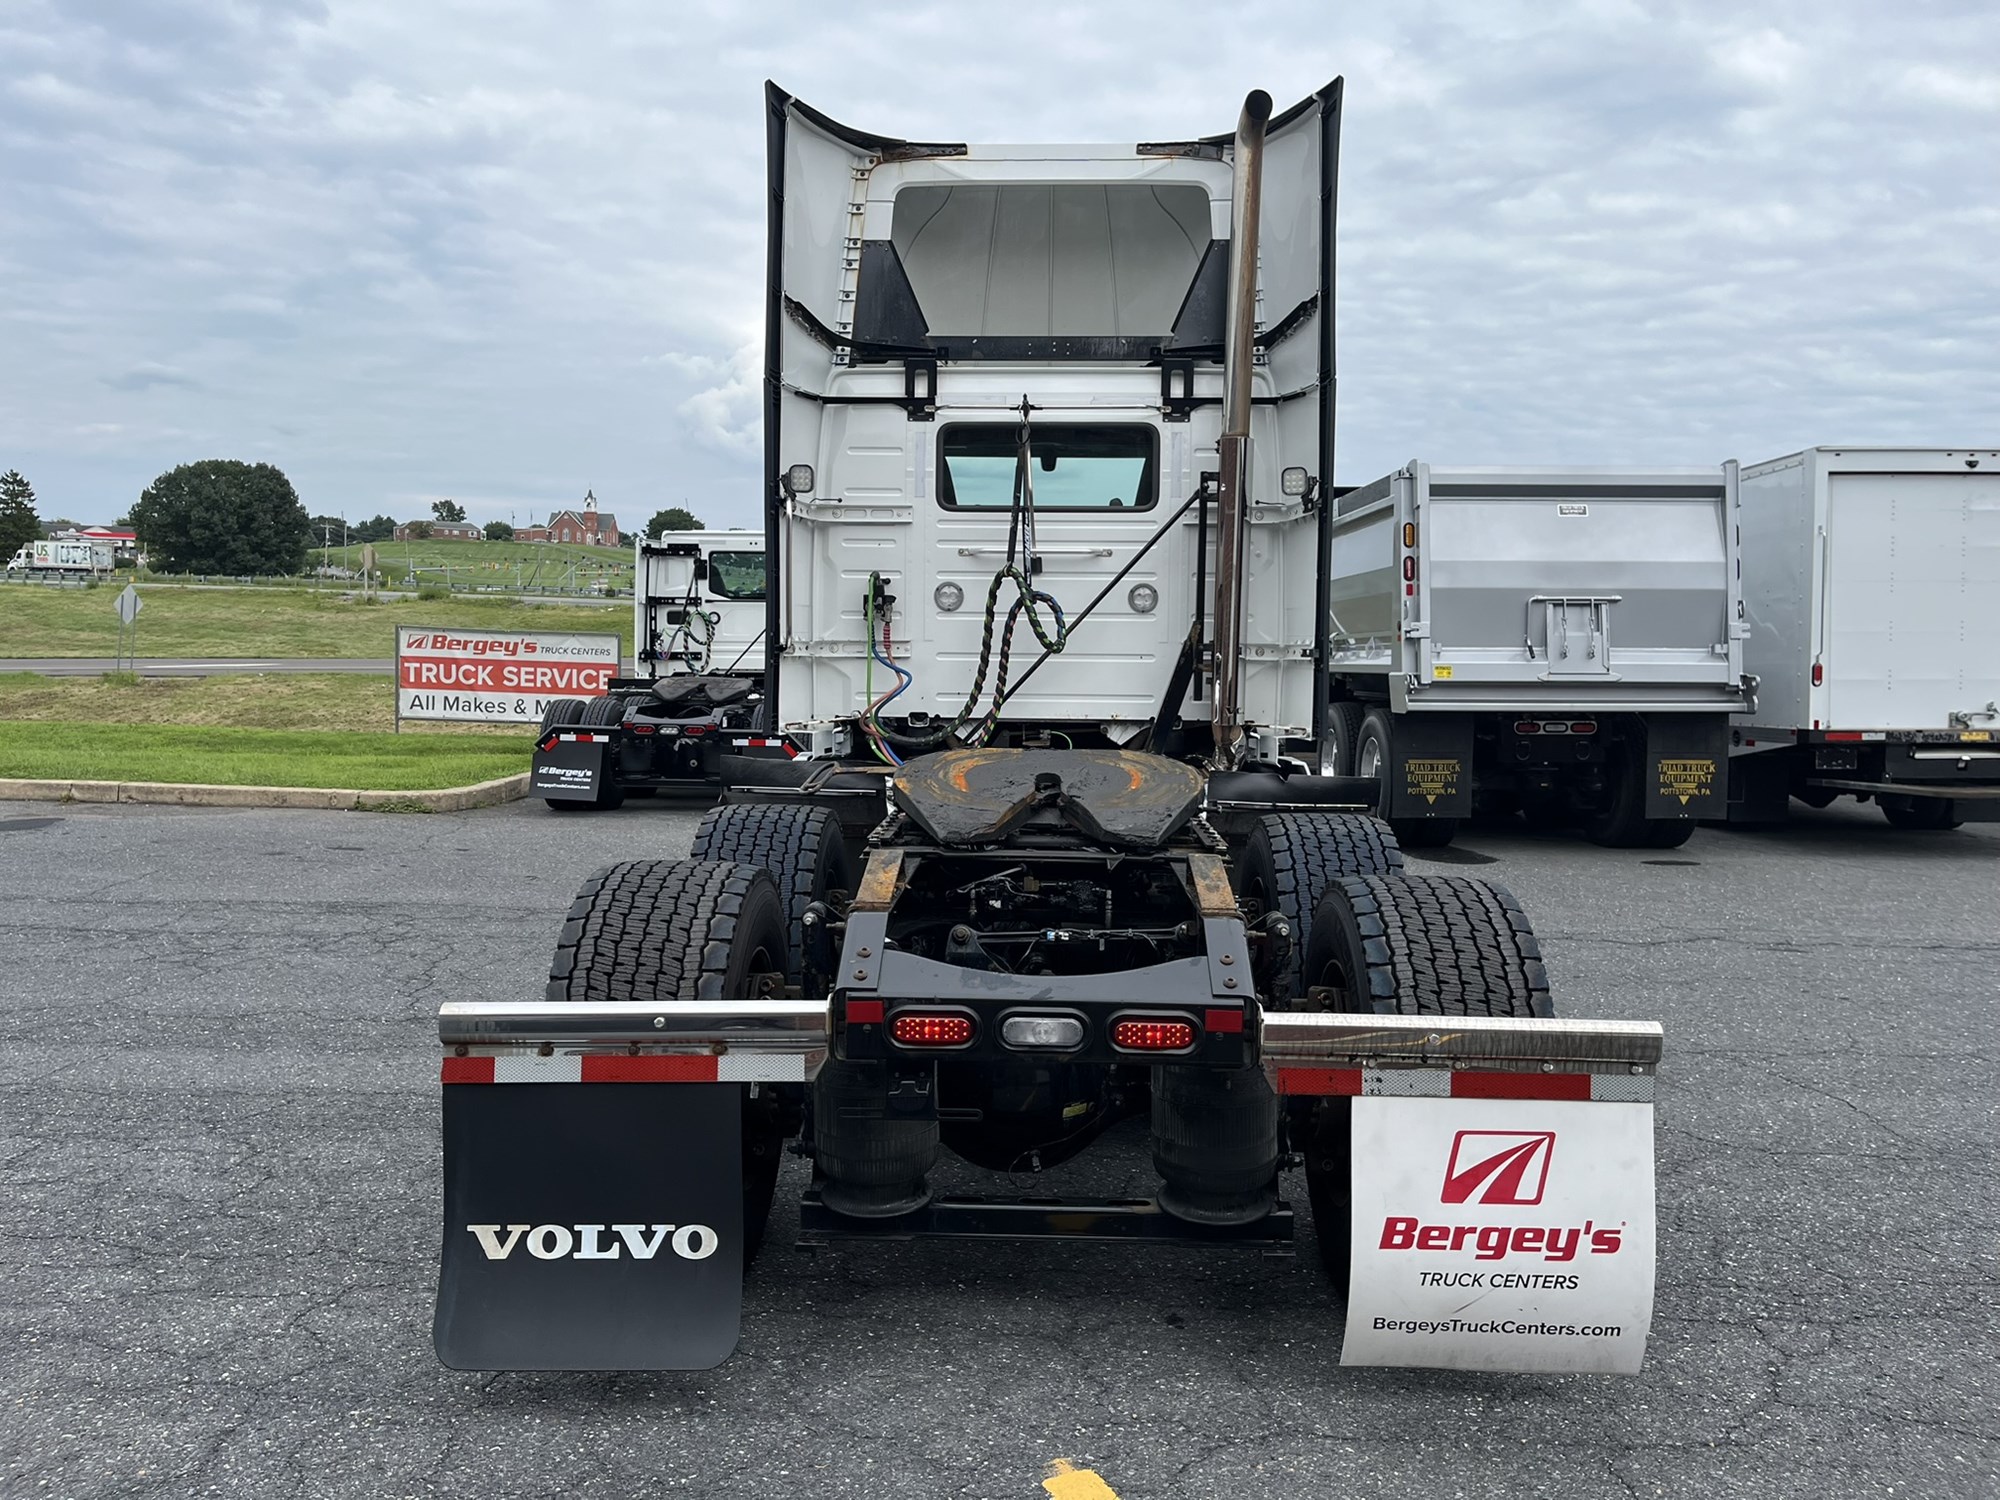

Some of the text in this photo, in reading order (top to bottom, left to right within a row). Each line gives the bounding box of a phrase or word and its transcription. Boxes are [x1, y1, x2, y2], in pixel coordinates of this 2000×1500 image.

[431, 634, 612, 657] Bergey's TRUCK CENTERS
[404, 662, 613, 690] TRUCK SERVICE
[409, 694, 435, 711] All
[443, 696, 507, 714] Makes
[514, 698, 527, 715] &
[548, 766, 593, 778] Bergey's
[1404, 763, 1461, 772] TRIAD TRUCK
[1657, 763, 1716, 773] TRIAD TRUCK
[1407, 773, 1458, 784] EQUIPMENT
[1659, 774, 1713, 784] EQUIPMENT
[1447, 787, 1457, 795] PA
[1700, 788, 1711, 796] PA
[466, 1223, 719, 1260] VOLVO
[1378, 1216, 1622, 1262] Bergey's
[1419, 1271, 1580, 1290] TRUCK CENTERS
[1372, 1316, 1622, 1337] BergeysTruckCenters.com
